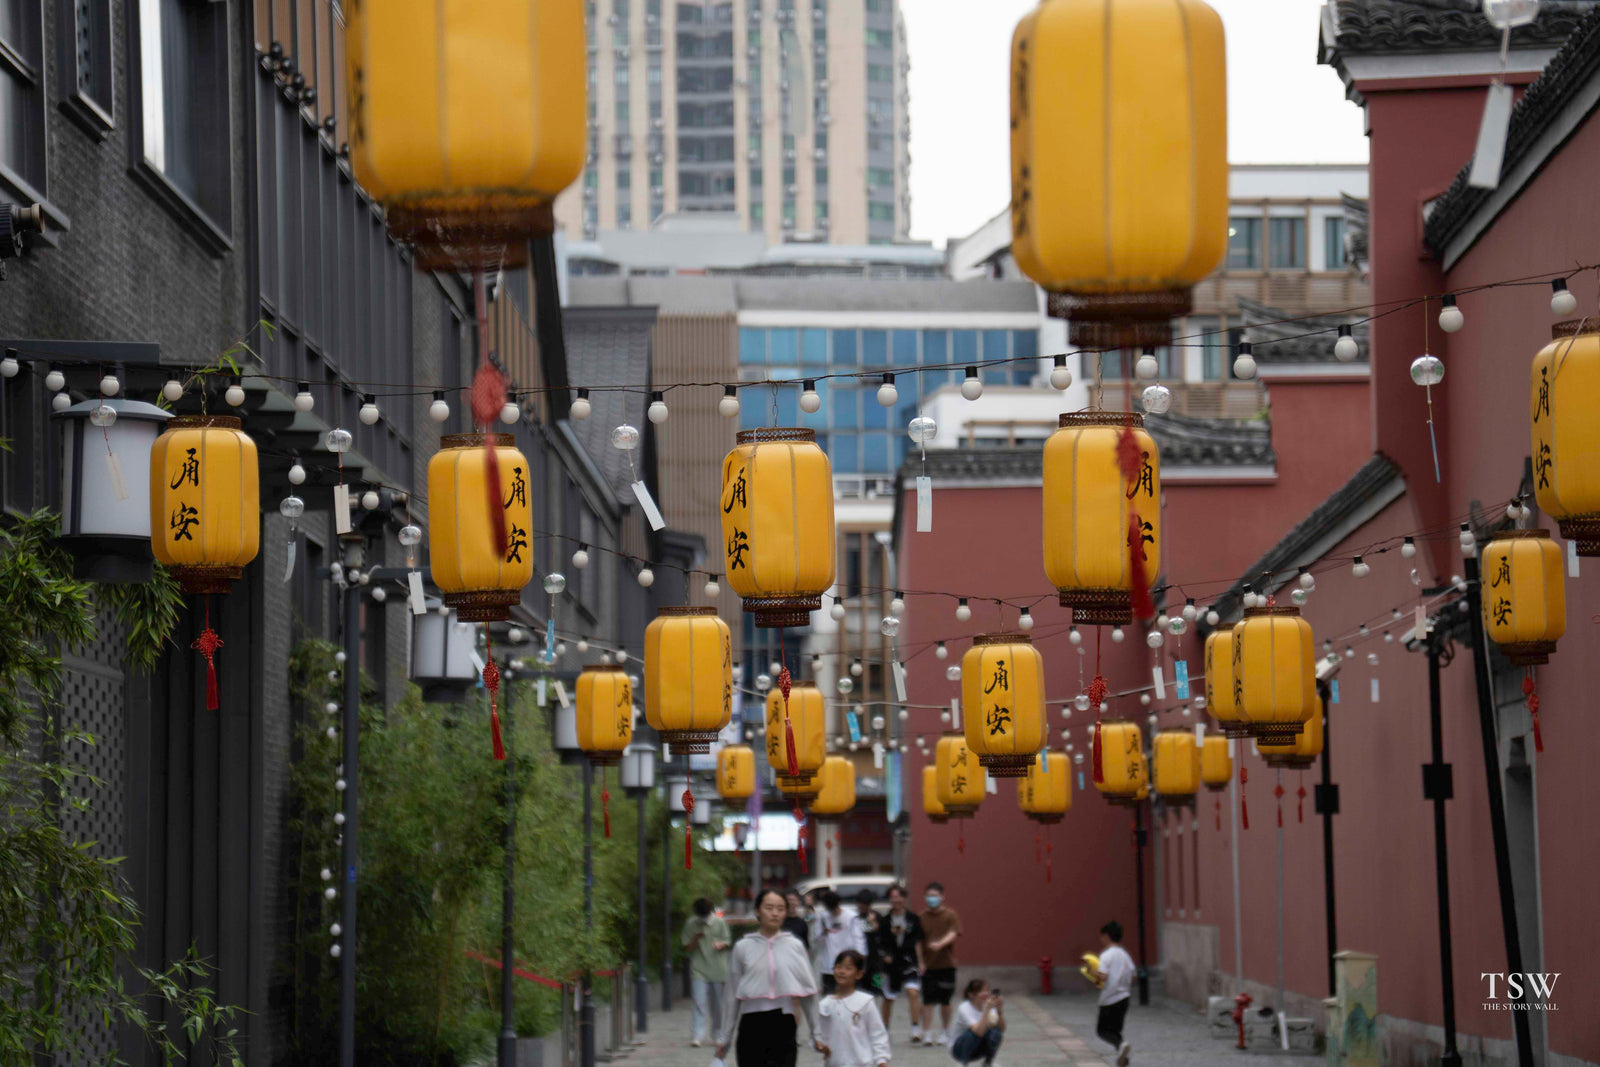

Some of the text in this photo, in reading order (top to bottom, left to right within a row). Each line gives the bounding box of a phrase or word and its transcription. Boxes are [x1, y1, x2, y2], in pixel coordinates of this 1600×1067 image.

[1533, 365, 1552, 490] 甬安
[170, 447, 200, 541] 甬安
[723, 466, 749, 571] 甬安
[1492, 556, 1512, 626] 甬安
[984, 660, 1011, 735] 甬安
